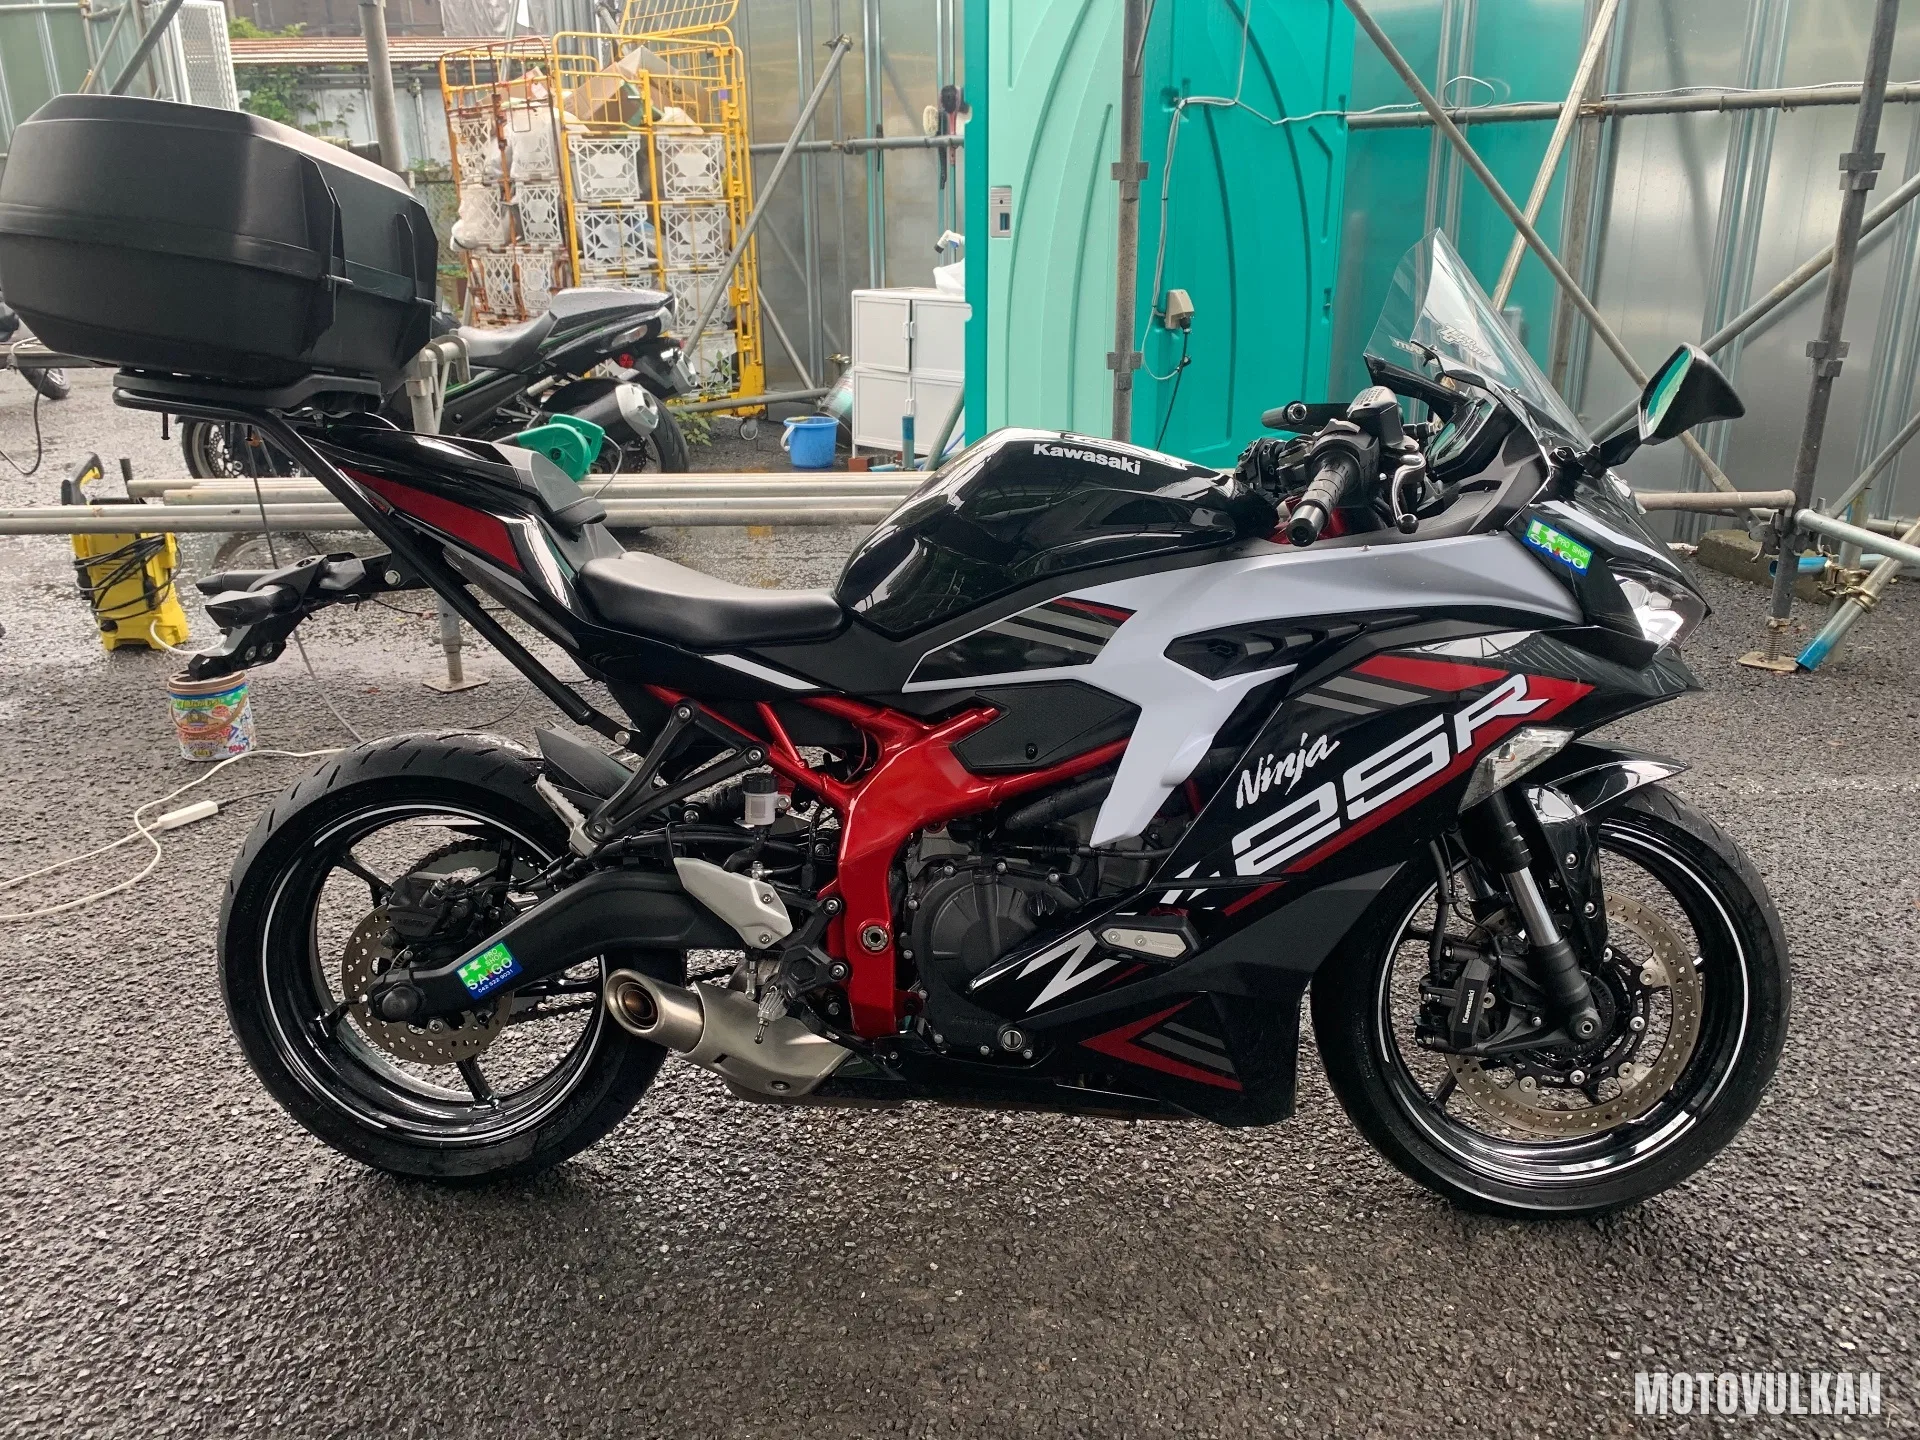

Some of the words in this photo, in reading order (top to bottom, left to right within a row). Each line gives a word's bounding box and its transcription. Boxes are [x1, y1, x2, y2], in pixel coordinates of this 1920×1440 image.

[1033, 443, 1140, 475] Kawasaki
[1571, 546, 1588, 558] SHOP
[1236, 732, 1340, 809] Ninja
